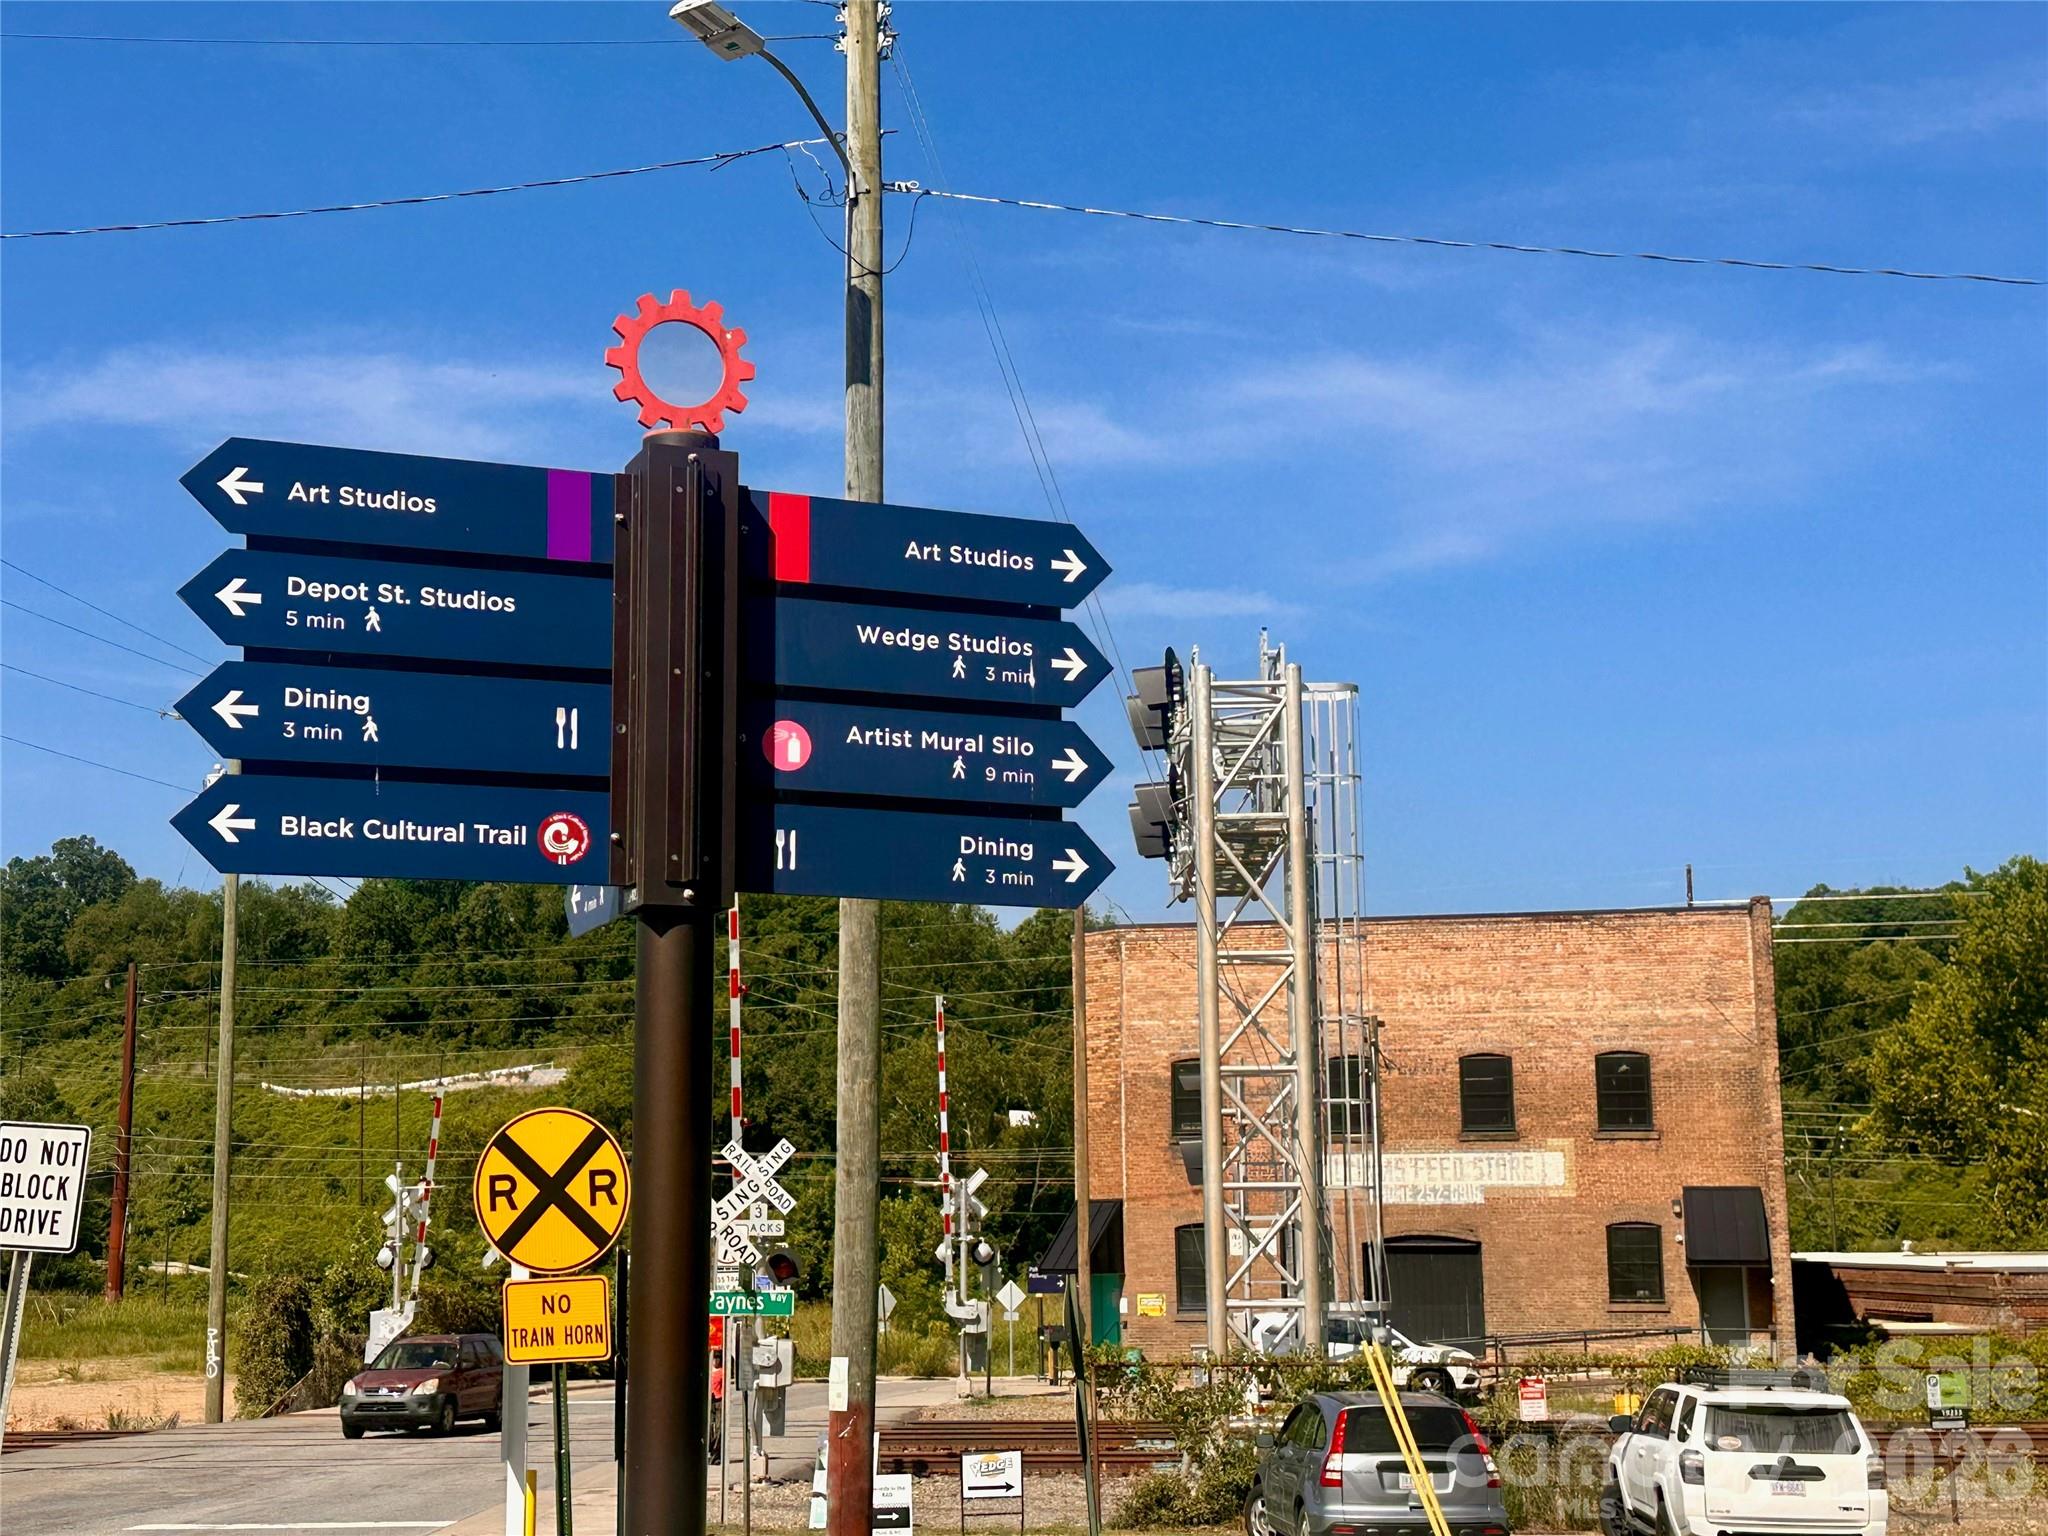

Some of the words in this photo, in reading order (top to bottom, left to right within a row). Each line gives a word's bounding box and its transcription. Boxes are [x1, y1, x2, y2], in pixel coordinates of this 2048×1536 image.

[287, 481, 330, 504] Art
[338, 486, 437, 513] Studios
[904, 541, 941, 562] Art
[949, 545, 1034, 571] Studios
[287, 576, 369, 602] Depot
[377, 583, 411, 605] St.
[420, 587, 516, 613] Studios
[285, 610, 298, 627] 5
[306, 613, 345, 630] min
[856, 624, 940, 650] Wedge
[948, 632, 1033, 657] Studios
[985, 666, 996, 682] 3
[1002, 665, 1033, 684] min
[284, 687, 370, 715] Dining
[282, 722, 296, 738] 3
[303, 724, 343, 741] min
[845, 725, 913, 748] Artist
[921, 731, 984, 754] Mural
[992, 736, 1034, 757] Silo
[985, 766, 997, 782] 9
[1002, 768, 1034, 784] min
[281, 815, 354, 839] Black
[362, 819, 465, 843] Cultural
[473, 823, 527, 846] Trail
[958, 835, 1034, 861] Dining
[985, 868, 996, 884] 3
[1002, 869, 1034, 886] min
[0, 1138, 27, 1164] DO
[40, 1140, 82, 1167] NOT
[725, 1144, 752, 1175] RAIL
[757, 1143, 791, 1177] SING
[1, 1173, 70, 1201] BLOCK
[489, 1173, 518, 1212] R
[588, 1168, 618, 1207] R
[716, 1179, 760, 1221] SING
[0, 1208, 62, 1236] DRIVE
[754, 1204, 763, 1219] 3
[749, 1223, 782, 1233] ACKS
[541, 1294, 571, 1315] NO
[769, 1293, 788, 1304] Way
[511, 1327, 554, 1348] TRAIN
[564, 1324, 604, 1345] HORN
[970, 1457, 1013, 1477] WEDGE
